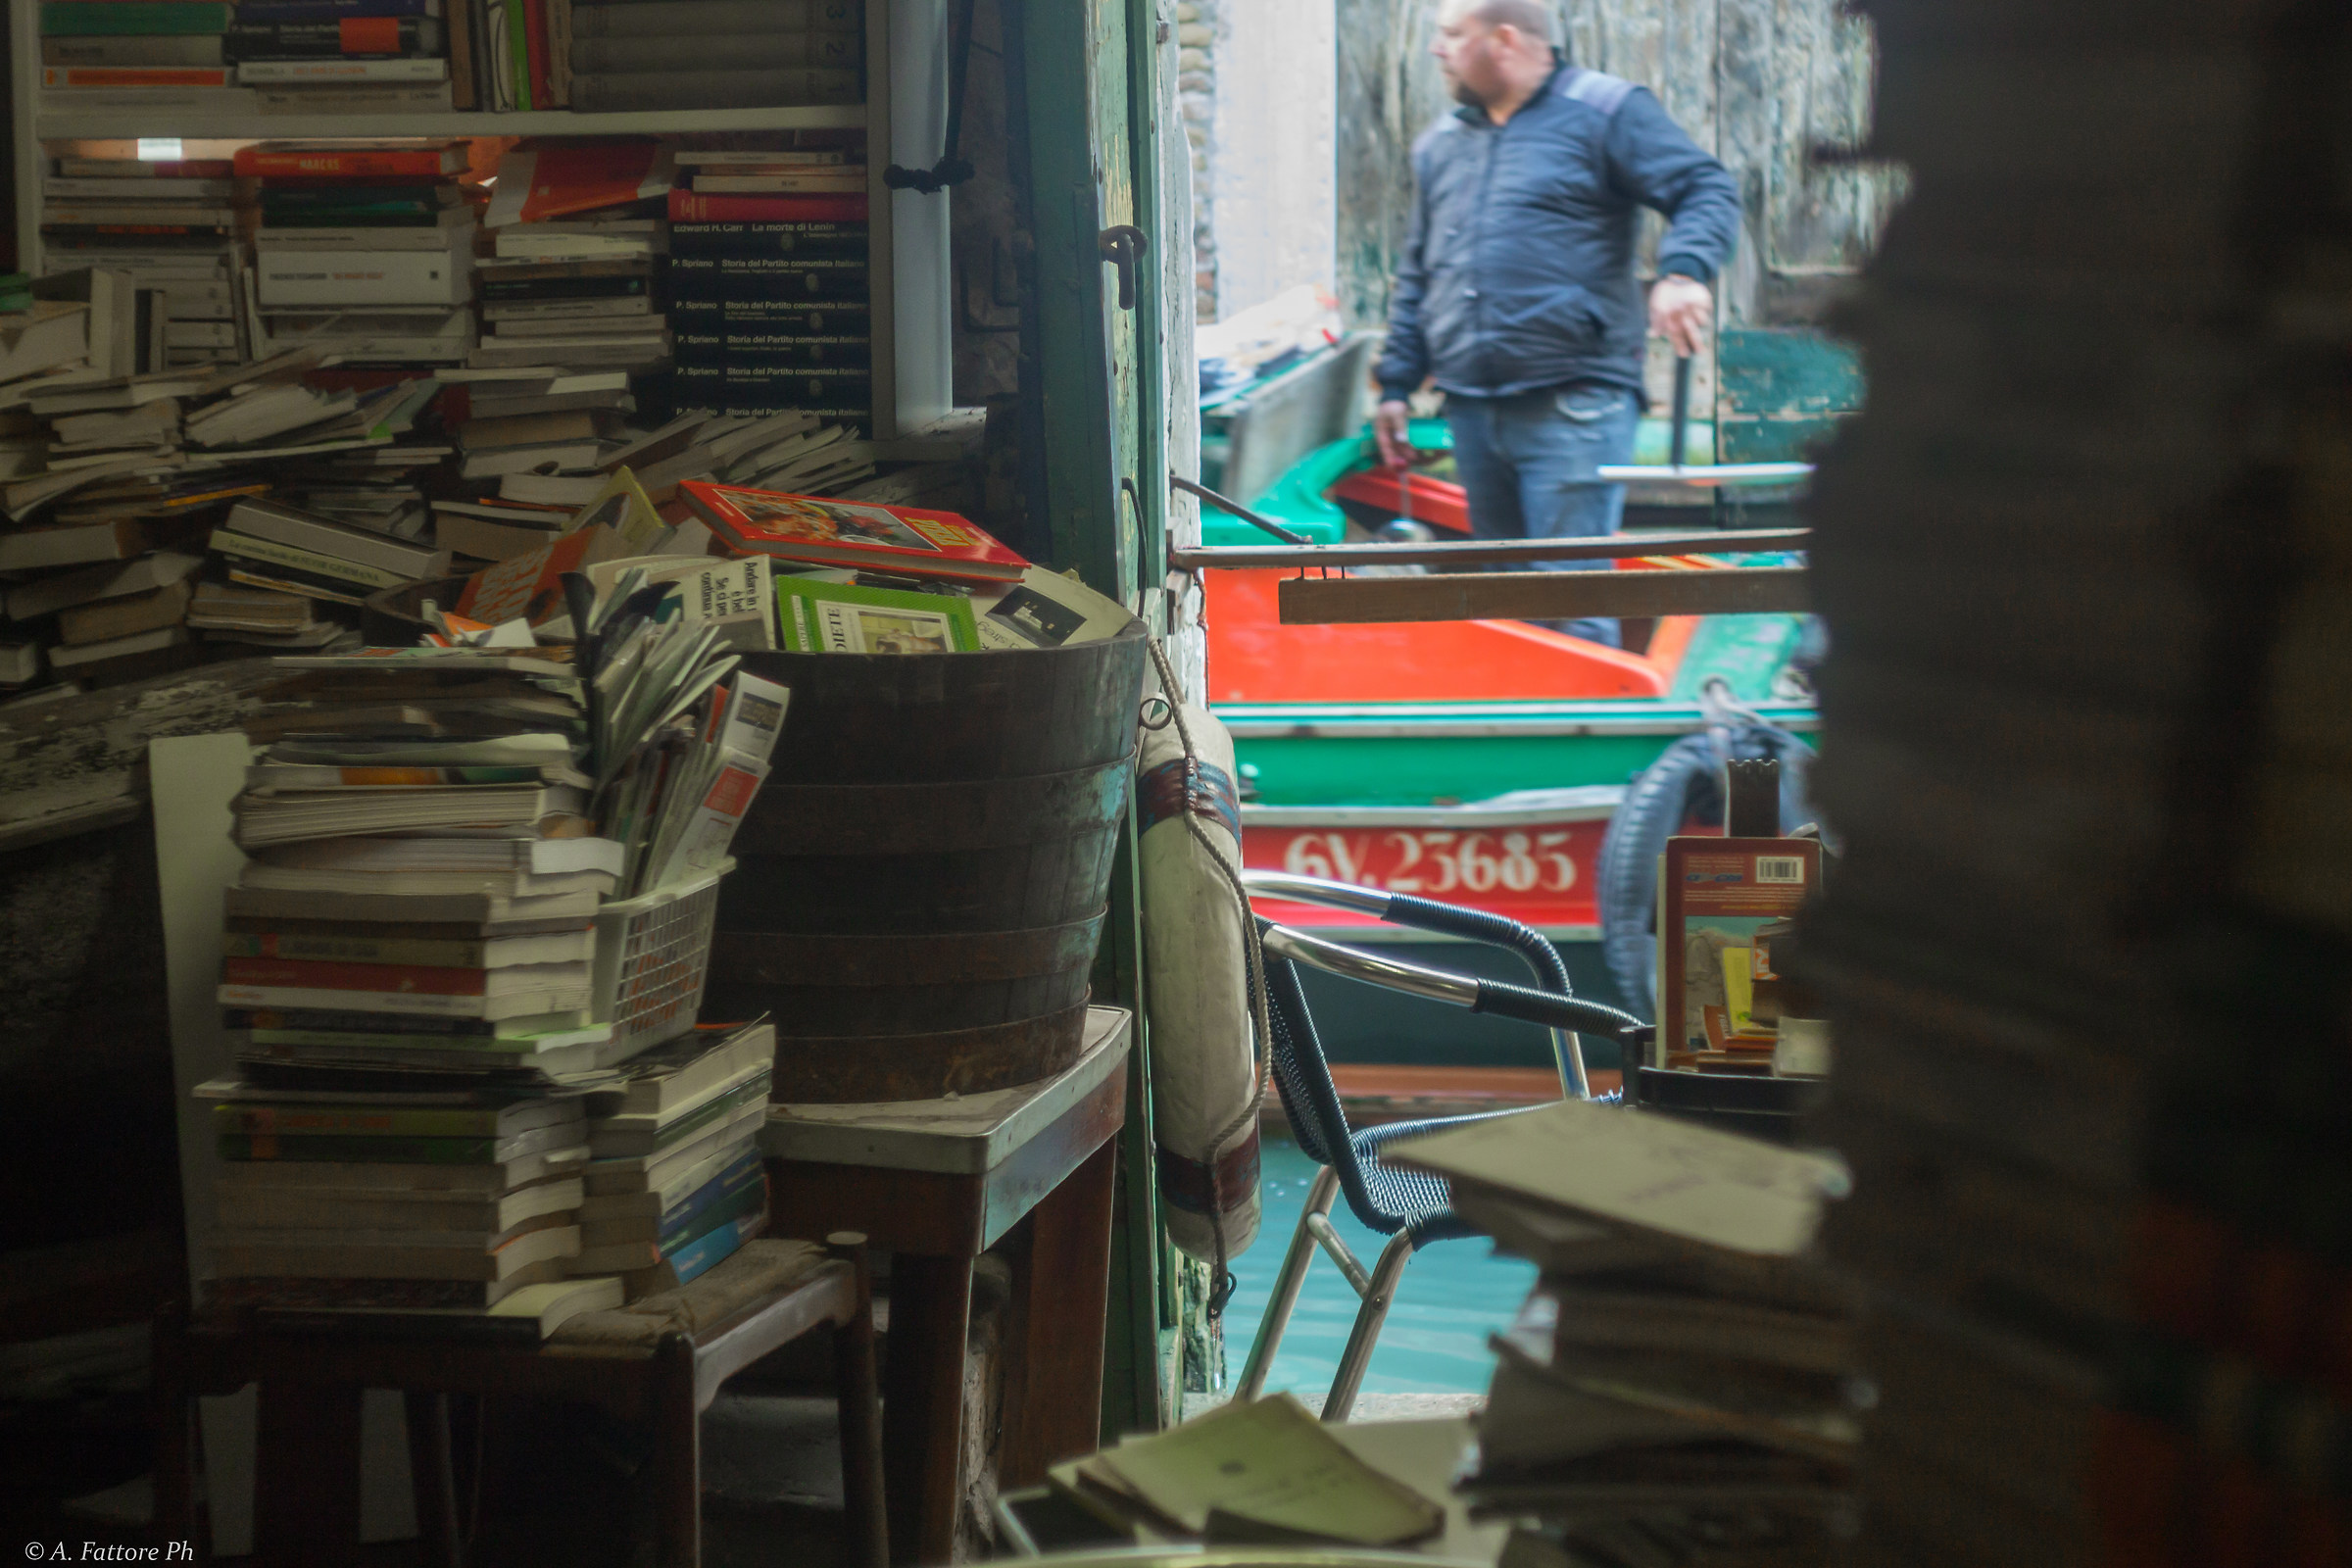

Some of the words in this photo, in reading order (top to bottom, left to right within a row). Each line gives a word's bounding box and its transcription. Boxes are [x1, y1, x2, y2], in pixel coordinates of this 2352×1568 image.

[673, 223, 710, 234] Edward
[723, 223, 744, 234] Carr
[752, 222, 764, 233] La
[766, 222, 795, 233] morte
[797, 221, 807, 233] di
[808, 221, 835, 233] Lenin
[672, 259, 680, 269] P.
[682, 259, 714, 270] Spriano
[721, 259, 746, 269] Storia
[748, 259, 760, 269] del
[761, 259, 789, 269] Partito
[791, 259, 833, 269] comunista
[835, 259, 864, 269] italiano
[676, 301, 684, 311] P.
[686, 301, 717, 312] Spriano
[725, 301, 749, 311] Storia
[751, 301, 763, 311] del
[765, 301, 792, 311] Partito
[794, 301, 836, 311] comunista
[837, 301, 868, 311] italiano
[678, 335, 686, 344] P.
[688, 335, 719, 345] Spriano
[727, 335, 751, 344] Storia
[753, 335, 765, 344] del
[767, 335, 794, 344] Partito
[796, 335, 838, 344] comunista
[840, 335, 870, 344] italiano
[678, 368, 686, 376] P.
[688, 368, 719, 377] Spriano
[727, 368, 751, 376] Storia
[753, 368, 765, 376] del
[767, 368, 794, 376] Partito
[795, 368, 837, 376] comunista
[840, 368, 869, 376] italiano
[799, 408, 837, 416] omunista
[716, 577, 729, 590] Se
[745, 562, 760, 594] Andare
[702, 572, 716, 612] continua
[716, 592, 730, 601] ci
[747, 596, 760, 606] in
